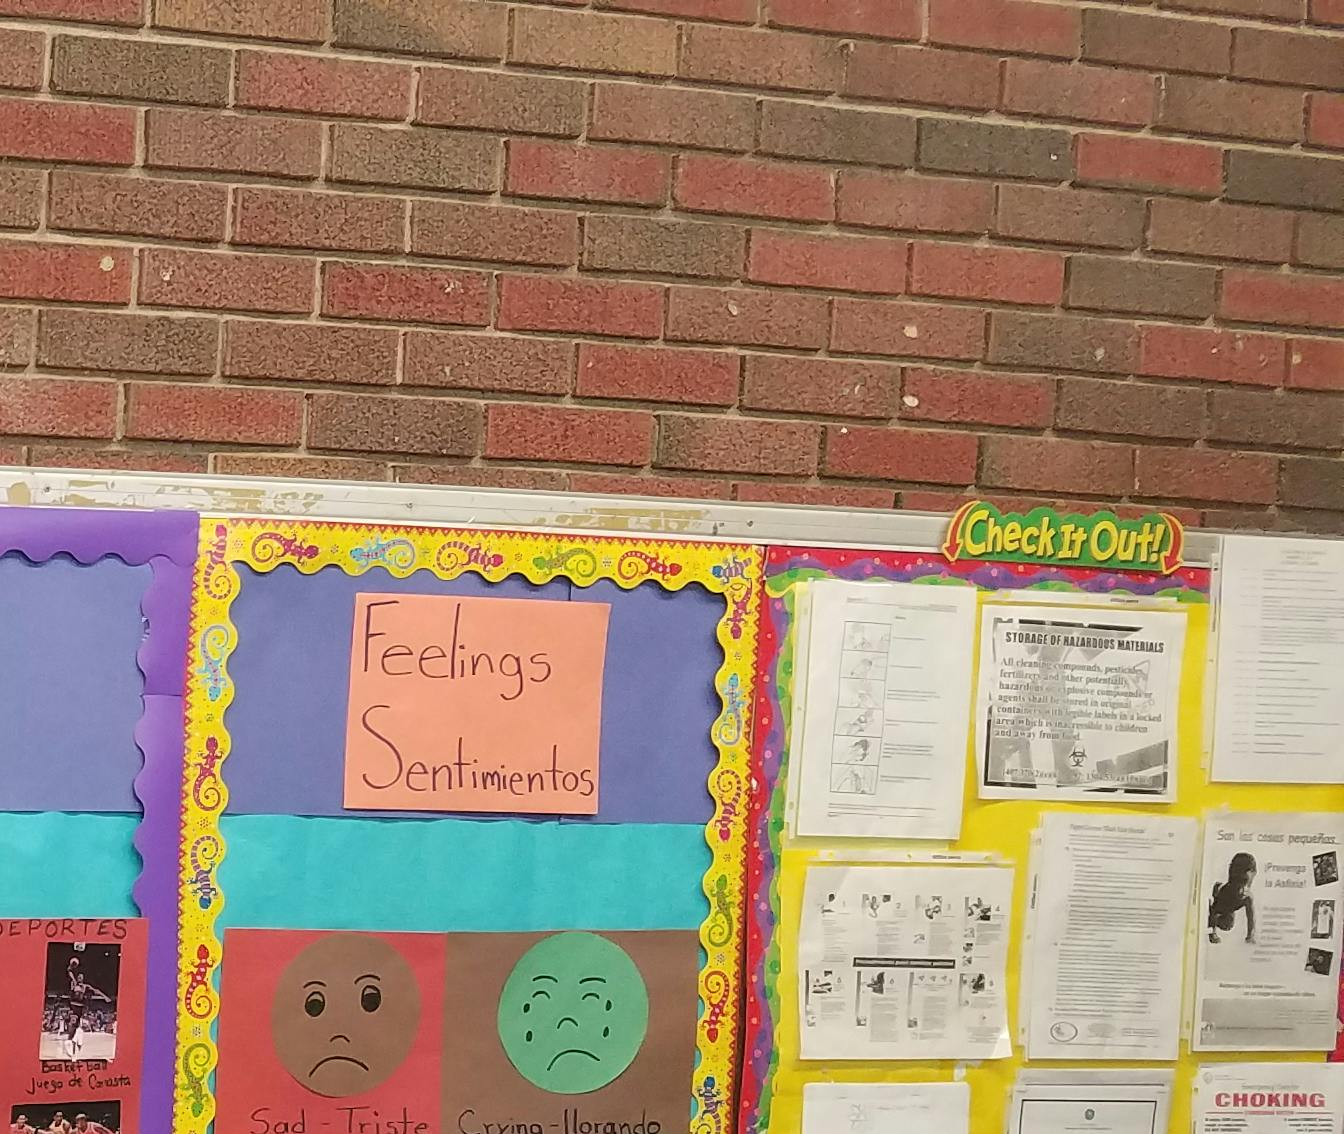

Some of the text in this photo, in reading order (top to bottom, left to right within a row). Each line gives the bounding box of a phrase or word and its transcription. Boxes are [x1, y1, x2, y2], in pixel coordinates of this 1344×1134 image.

[964, 510, 1165, 562] Check It Out!
[361, 599, 553, 701] Feelings
[1005, 632, 1164, 653] STORAGE OF HAZARDOUS MATERIALS
[360, 704, 596, 798] Sentimientos
[68, 1074, 84, 1088] de
[1214, 1091, 1326, 1108] CHOKING
